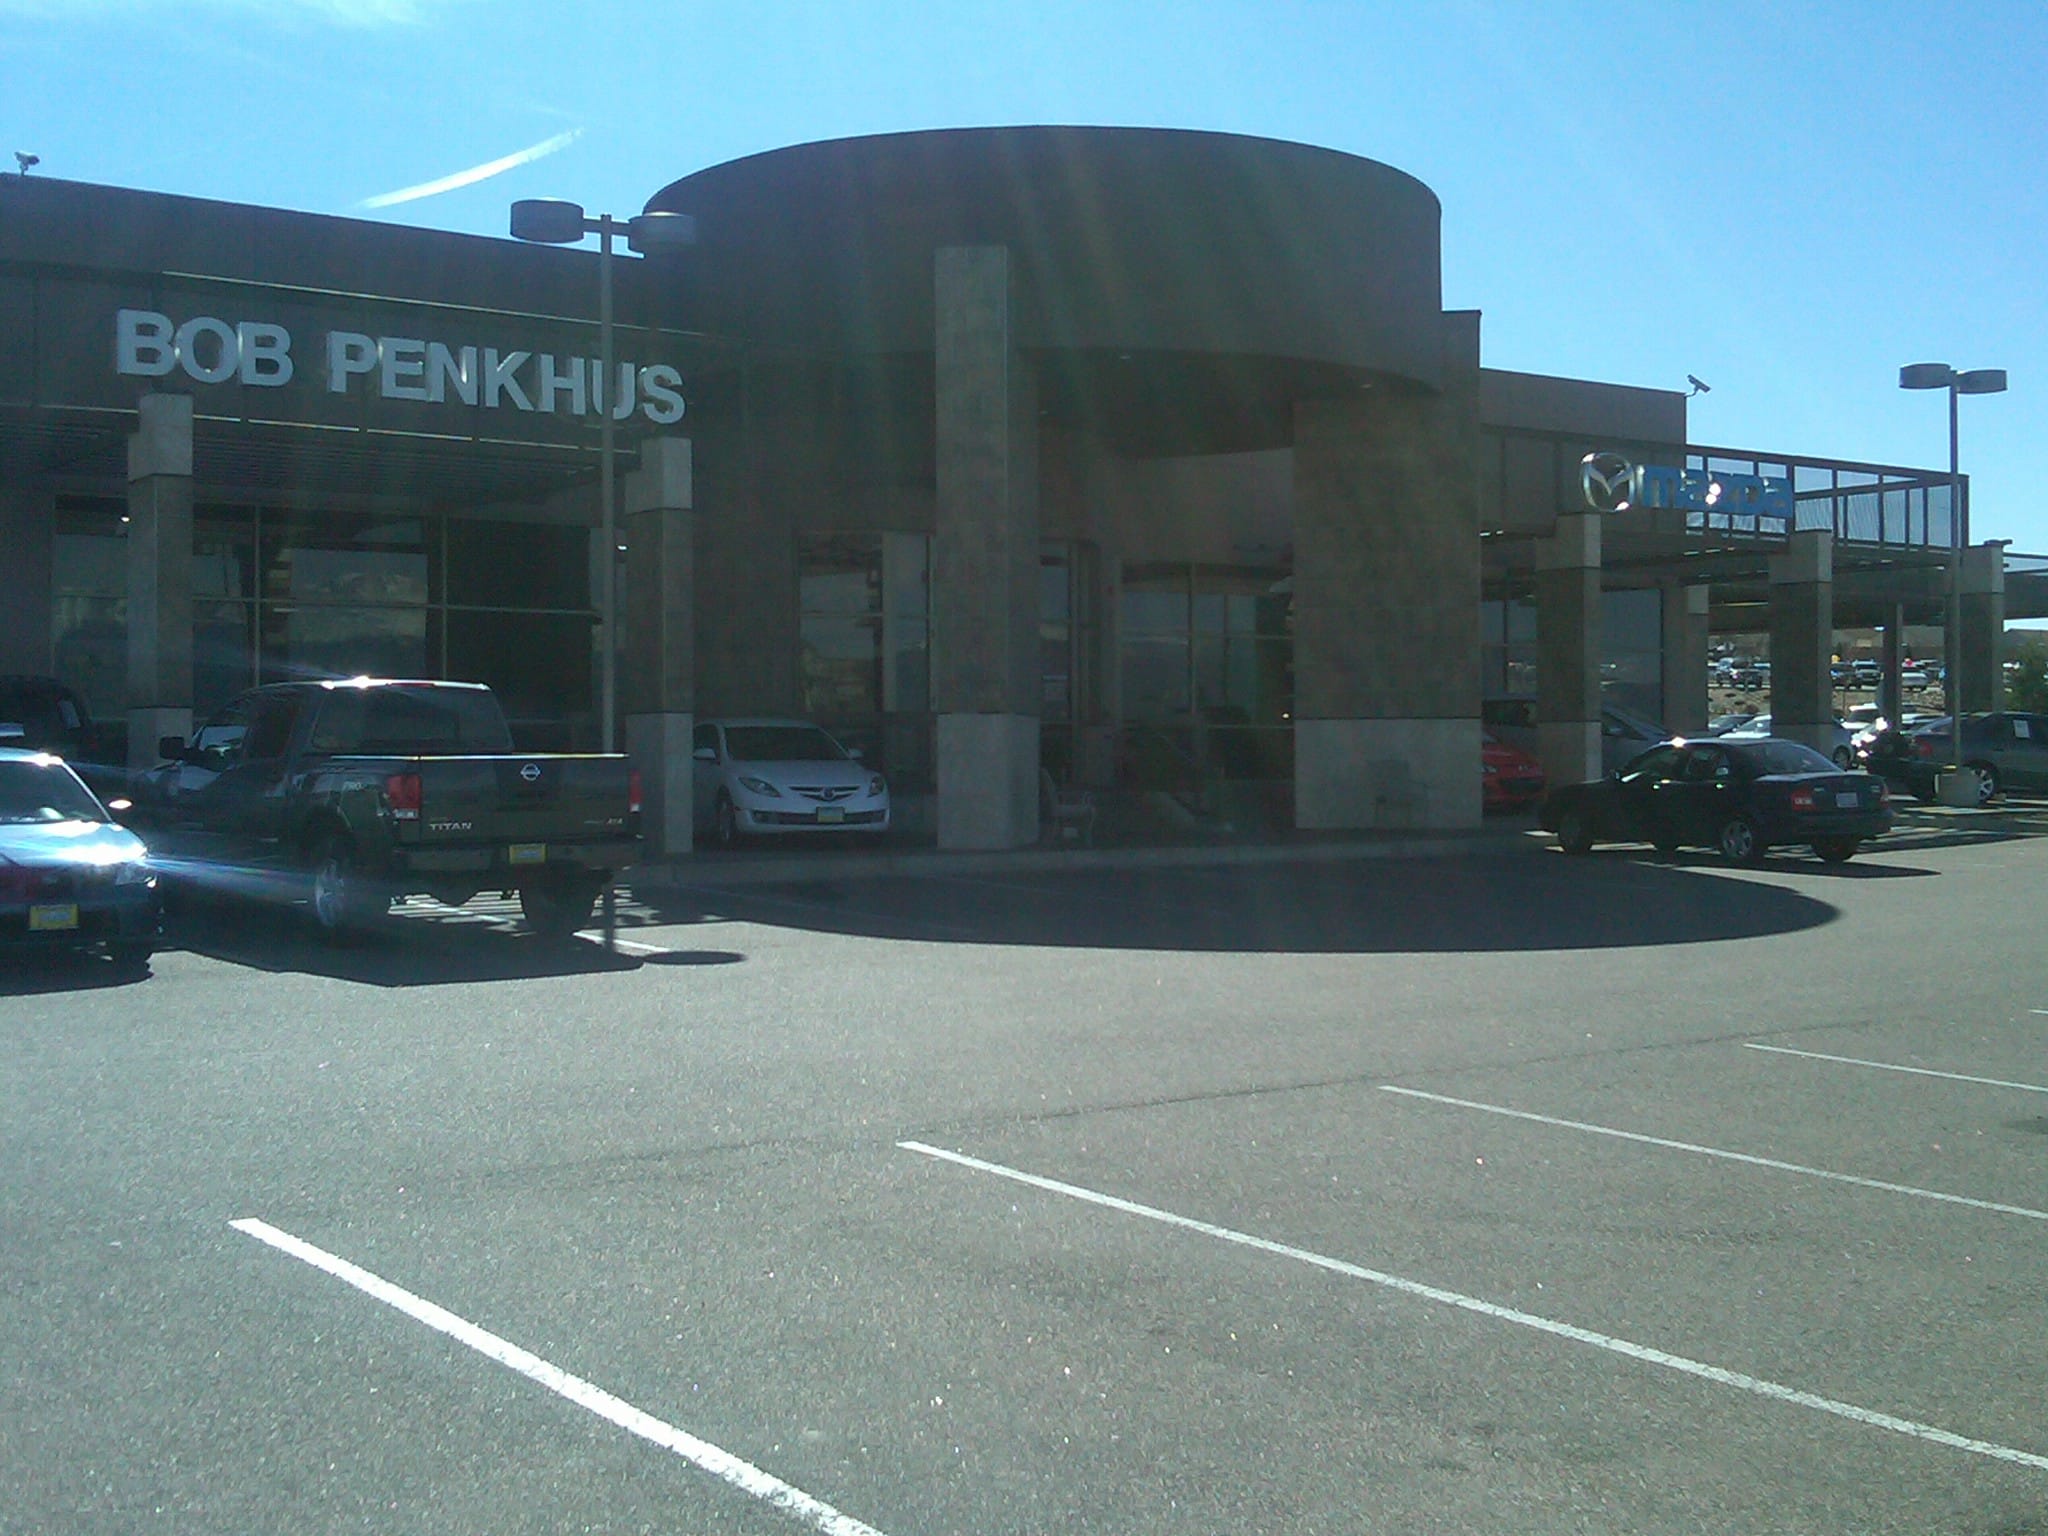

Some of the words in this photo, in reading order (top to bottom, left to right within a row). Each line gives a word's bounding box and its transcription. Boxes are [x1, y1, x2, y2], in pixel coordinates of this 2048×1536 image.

[117, 308, 294, 387] BOB
[326, 330, 686, 425] PENKHUS
[429, 822, 472, 831] TITAN
